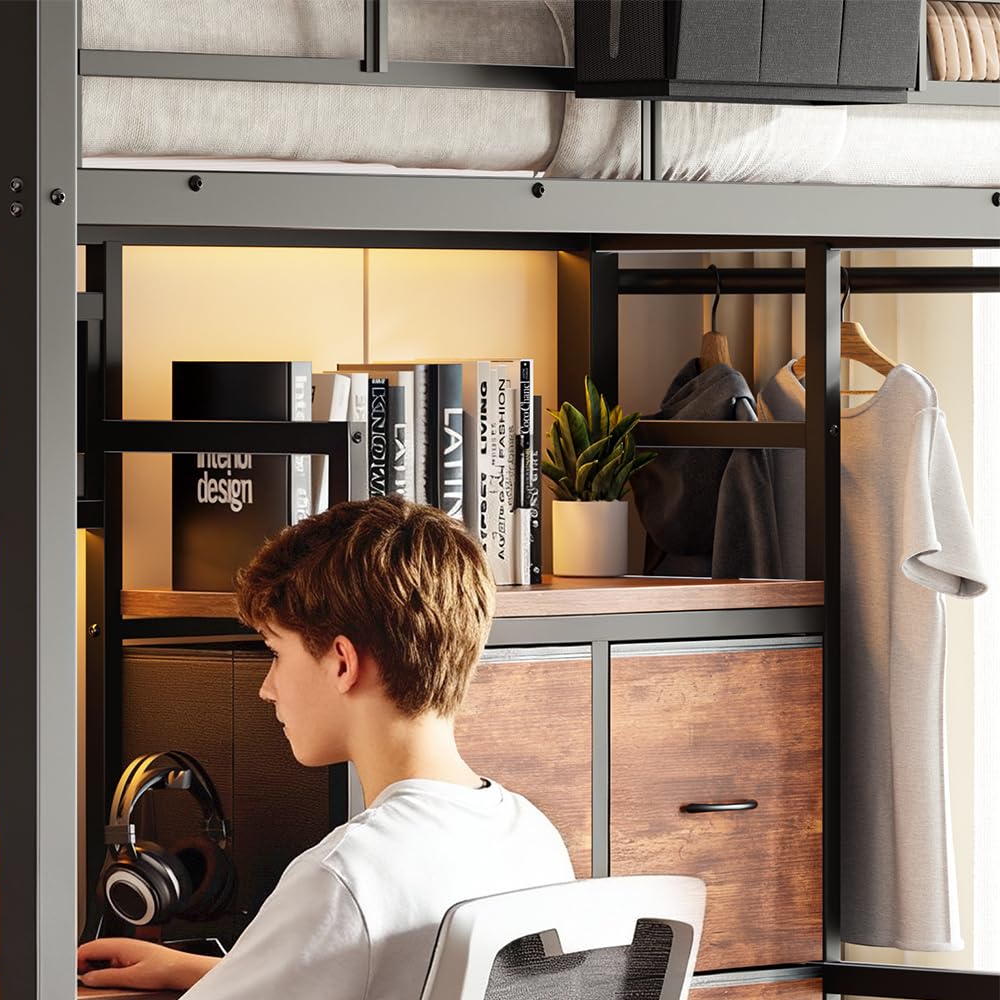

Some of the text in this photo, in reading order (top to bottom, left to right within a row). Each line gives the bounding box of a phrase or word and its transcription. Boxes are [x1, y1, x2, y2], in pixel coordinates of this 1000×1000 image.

[480, 381, 488, 454] LIVING
[520, 411, 530, 434] Coco
[197, 470, 253, 512] design
